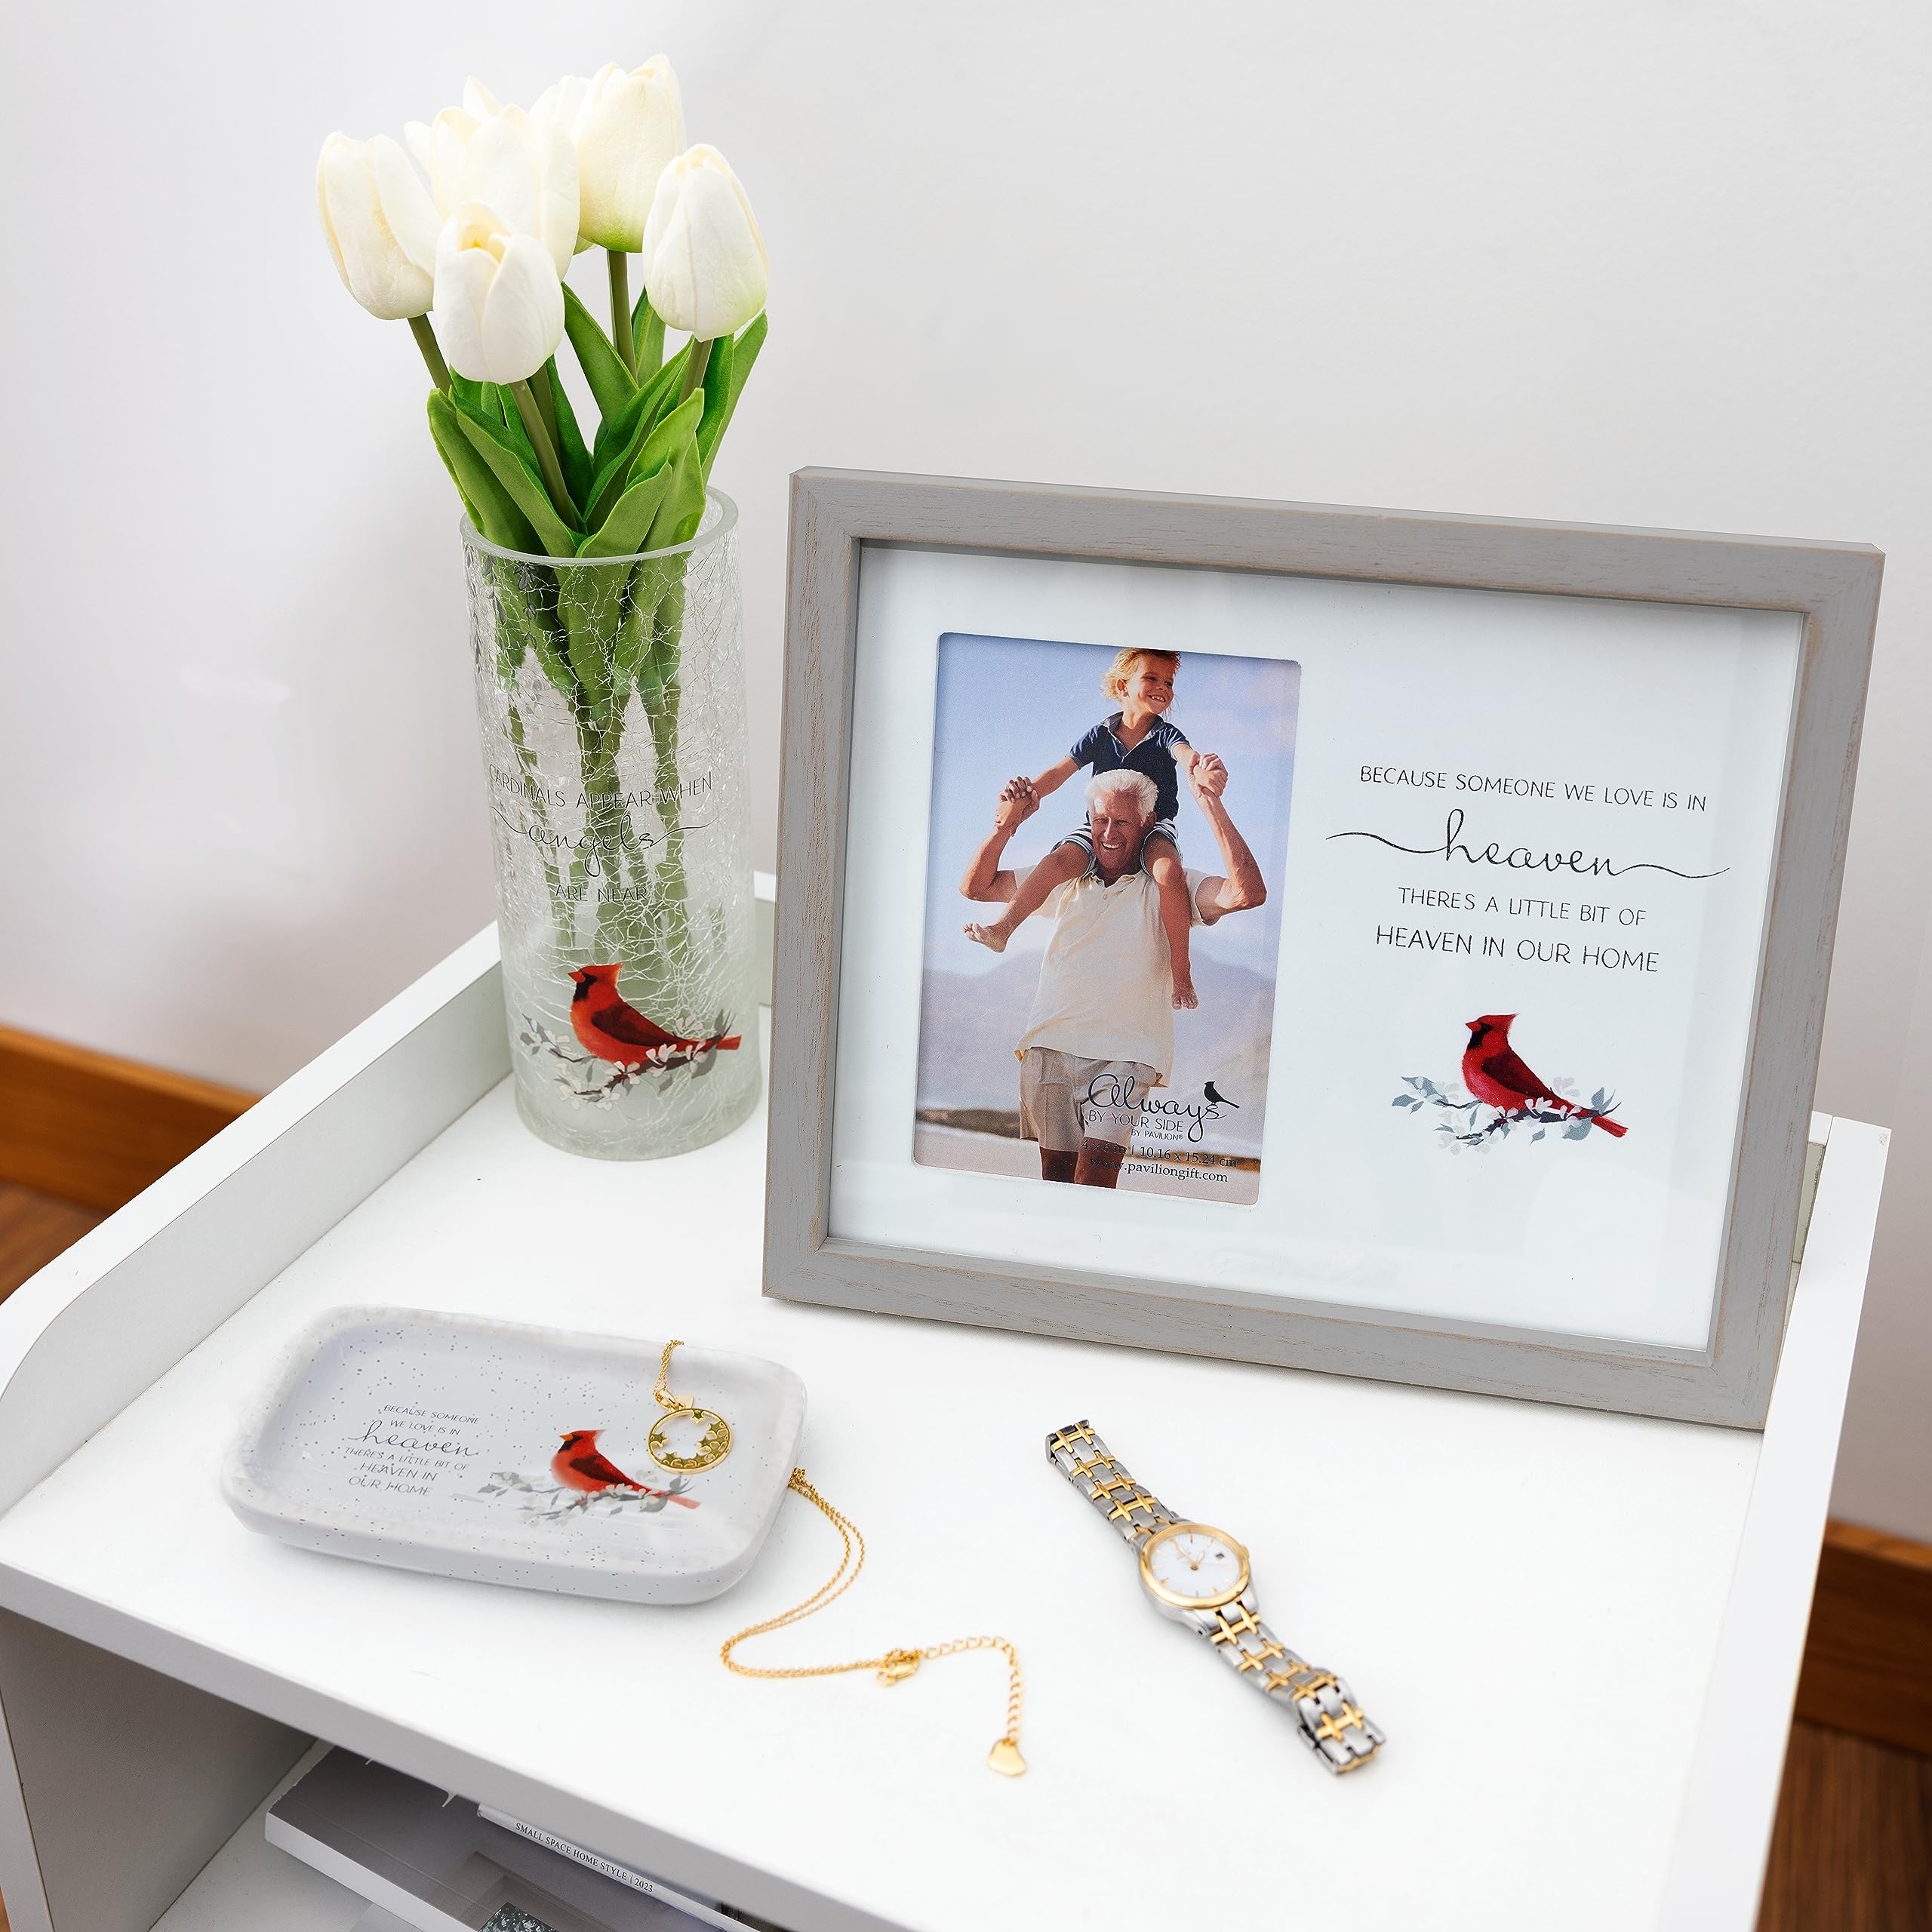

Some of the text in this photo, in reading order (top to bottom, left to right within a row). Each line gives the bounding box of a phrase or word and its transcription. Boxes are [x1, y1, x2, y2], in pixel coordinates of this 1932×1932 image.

[489, 764, 712, 809] CARDINALS APPEAR WHEN
[1360, 765, 1706, 812] BECAUSE SOMEONE WE LOVE IS IN
[555, 884, 648, 903] ARE NEAR
[1398, 887, 1647, 926] THERES A LITTLE BIT OF
[1377, 924, 1660, 972] HEAVEN IN OUR HOME
[1088, 1073, 1228, 1143] Always
[1088, 1109, 1184, 1132] BY YOUR SIDE
[1131, 1128, 1142, 1137] BY
[1082, 1138, 1090, 1149] 4
[1093, 1143, 1100, 1152] x
[1103, 1141, 1111, 1152] 6
[1140, 1146, 1171, 1160] 10.16
[1174, 1152, 1182, 1161] x
[1186, 1152, 1216, 1165] 15.24
[1219, 1158, 1238, 1168] cm
[1090, 1158, 1229, 1183] www.paviliongift.com
[383, 1404, 481, 1425] BECAUSE SOMEONE
[347, 1420, 481, 1457] heaven
[389, 1420, 406, 1429] WE
[408, 1422, 435, 1432] LOVE
[449, 1428, 461, 1436] IN
[360, 1462, 438, 1481] HEAVEN IN
[398, 1455, 431, 1466] LITTLE
[435, 1460, 451, 1469] BIT
[454, 1463, 471, 1471] OF
[349, 1476, 432, 1497] OUR HOME
[515, 1823, 543, 1841] SMALL
[545, 1836, 571, 1855] SPACE
[573, 1849, 598, 1867] HOME
[600, 1862, 627, 1881] STYLE
[635, 1878, 654, 1893] 2023
